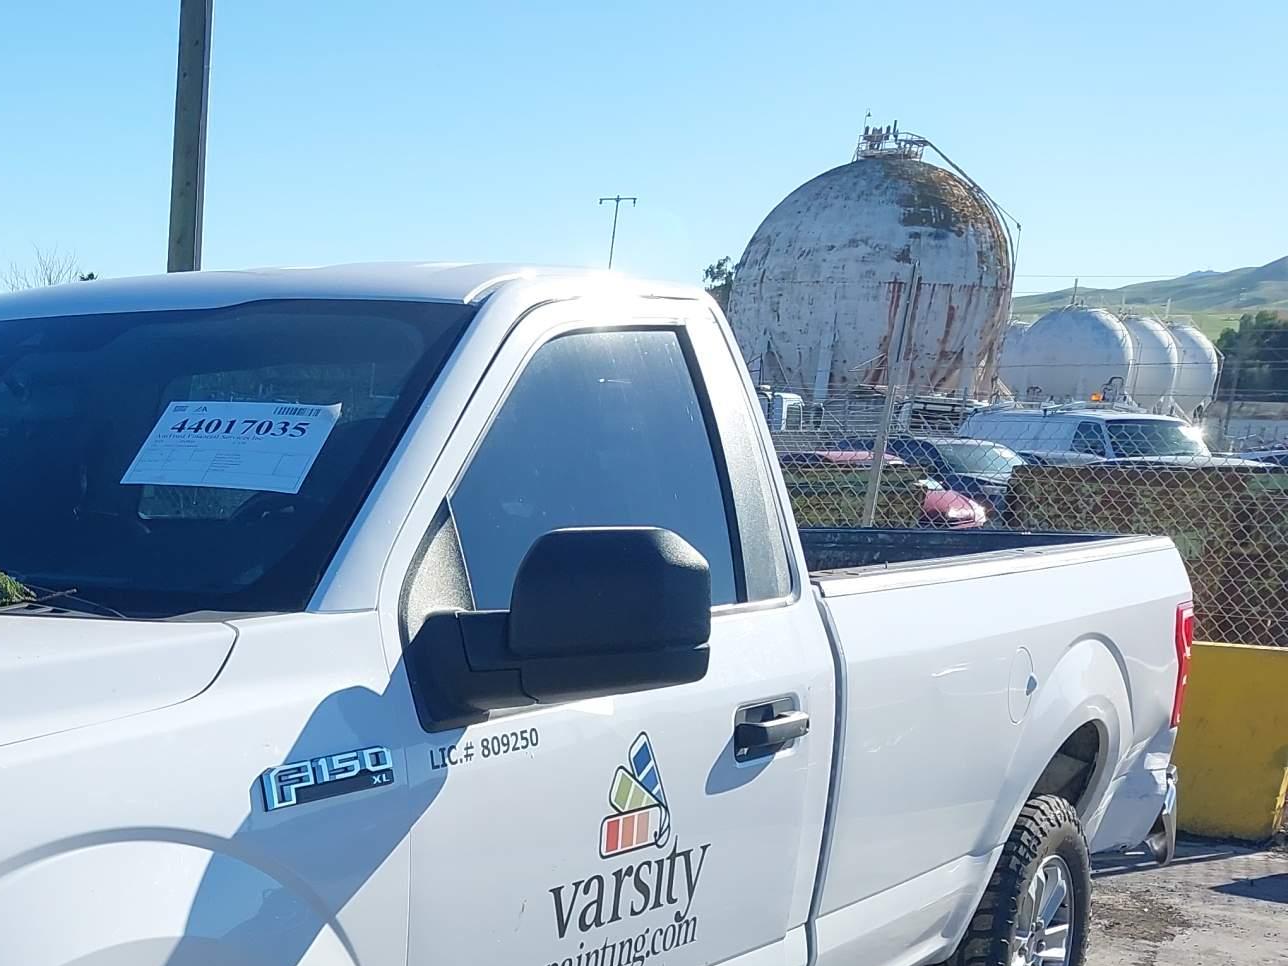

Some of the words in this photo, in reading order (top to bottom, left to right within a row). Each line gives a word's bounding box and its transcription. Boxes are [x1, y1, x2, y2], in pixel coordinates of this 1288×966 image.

[170, 418, 311, 438] 44017035
[429, 741, 475, 770] LIC.#
[480, 727, 540, 759] 809250
[372, 773, 391, 785] XL
[548, 835, 711, 939] varsity
